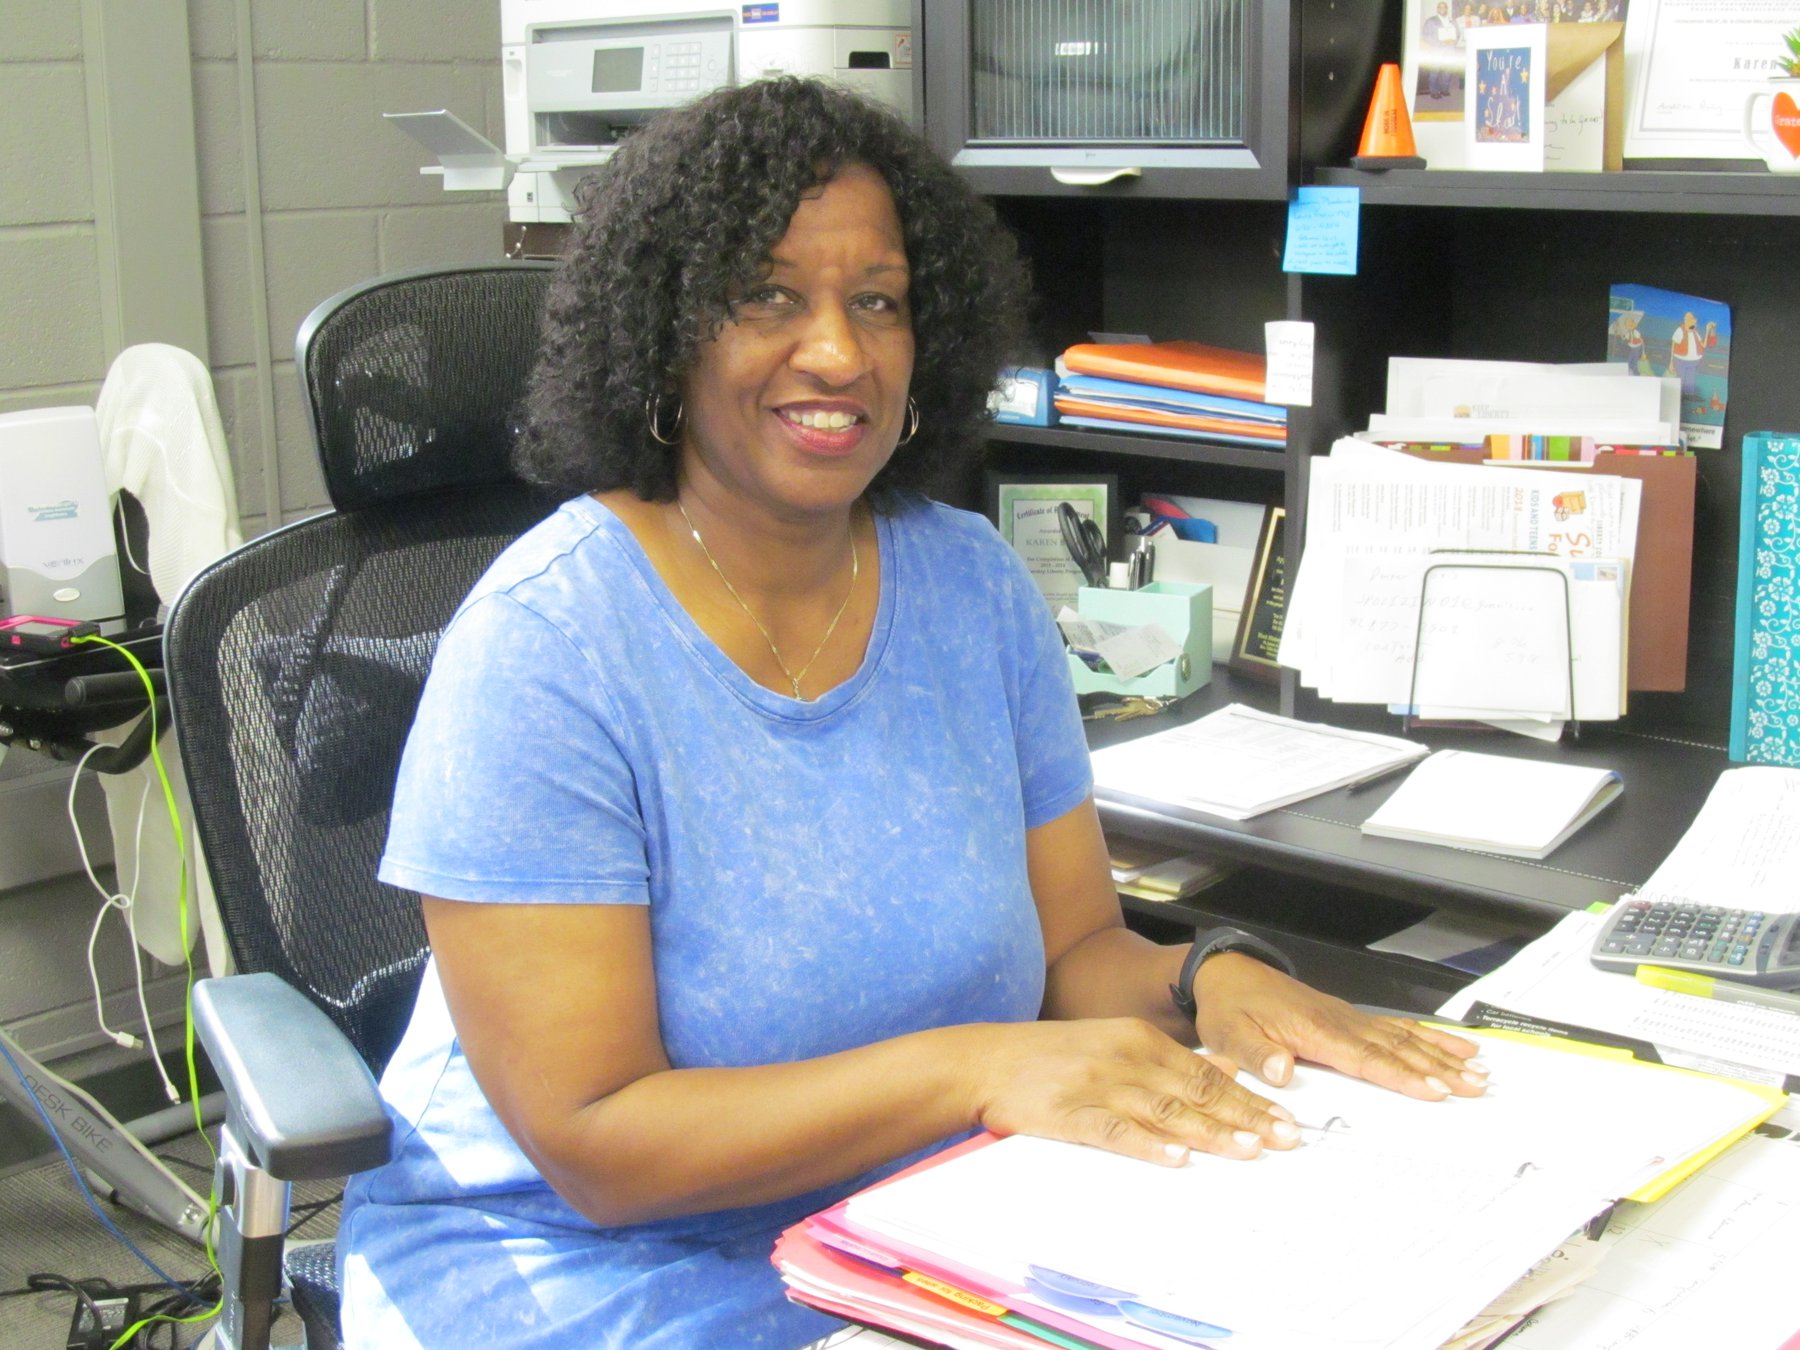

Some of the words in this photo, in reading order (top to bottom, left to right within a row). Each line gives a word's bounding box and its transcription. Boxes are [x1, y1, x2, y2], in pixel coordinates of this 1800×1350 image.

[1733, 57, 1778, 70] Karen
[1531, 489, 1540, 507] KIDS
[1530, 508, 1539, 525] AND
[1529, 526, 1538, 550] TEENS
[20, 1075, 72, 1120] DESK
[71, 1116, 113, 1154] BIKE
